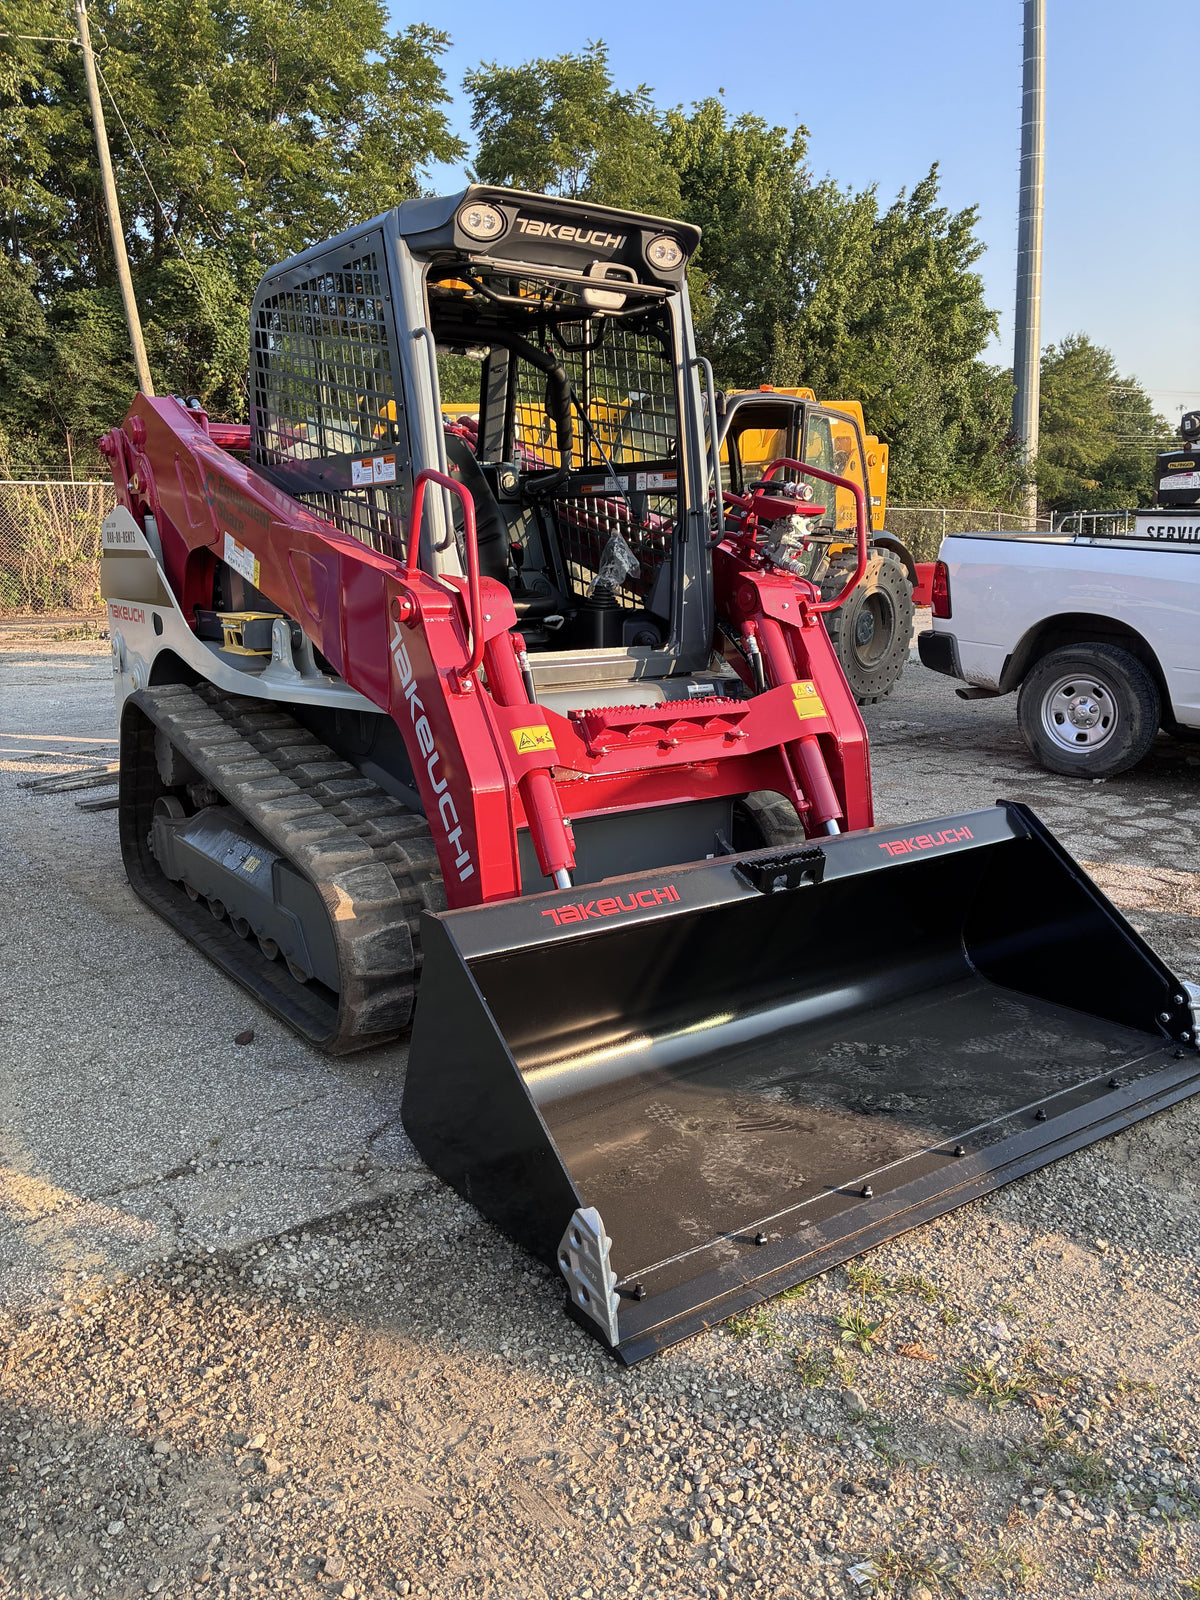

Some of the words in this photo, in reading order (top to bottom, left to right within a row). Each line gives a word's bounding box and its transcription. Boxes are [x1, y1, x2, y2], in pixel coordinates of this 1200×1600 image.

[517, 218, 627, 249] TAKEUCHI
[109, 604, 145, 624] TAKEUCHI
[390, 621, 475, 882] TAKEUCHI
[879, 826, 974, 857] TAKEUCHI
[541, 885, 681, 926] TAKEUCHI
